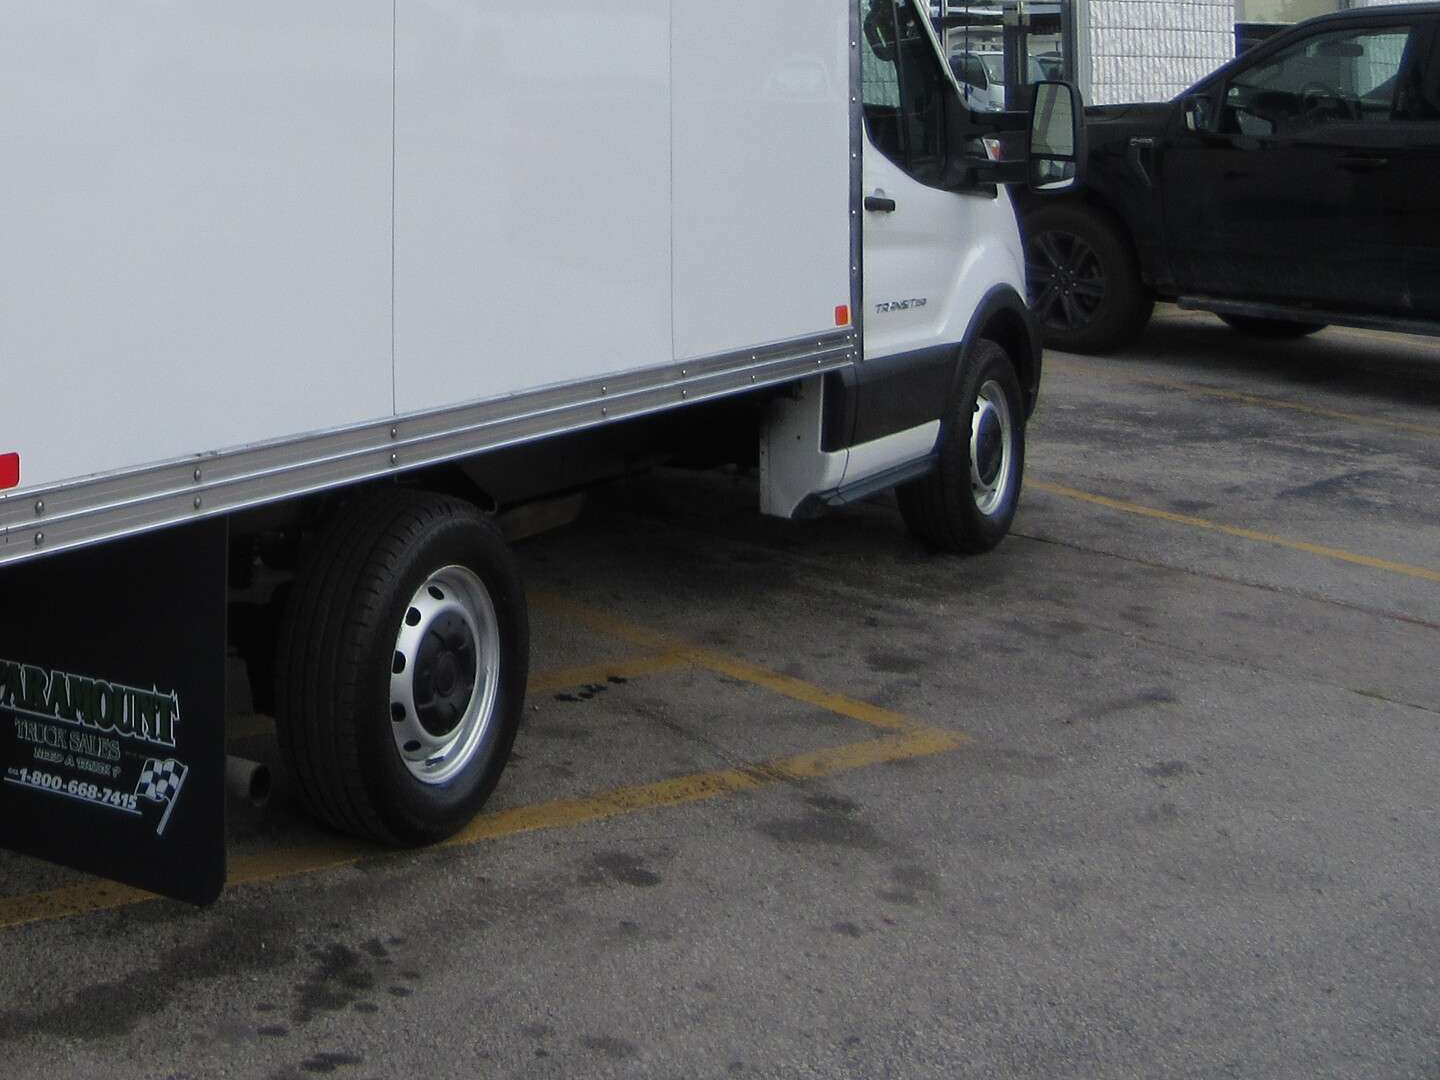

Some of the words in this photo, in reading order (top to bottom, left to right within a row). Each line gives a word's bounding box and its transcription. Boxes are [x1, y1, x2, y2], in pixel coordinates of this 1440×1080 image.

[14, 719, 67, 749] TRUCK
[69, 731, 121, 761] SALES
[19, 768, 138, 809] 1-800-668-7415
